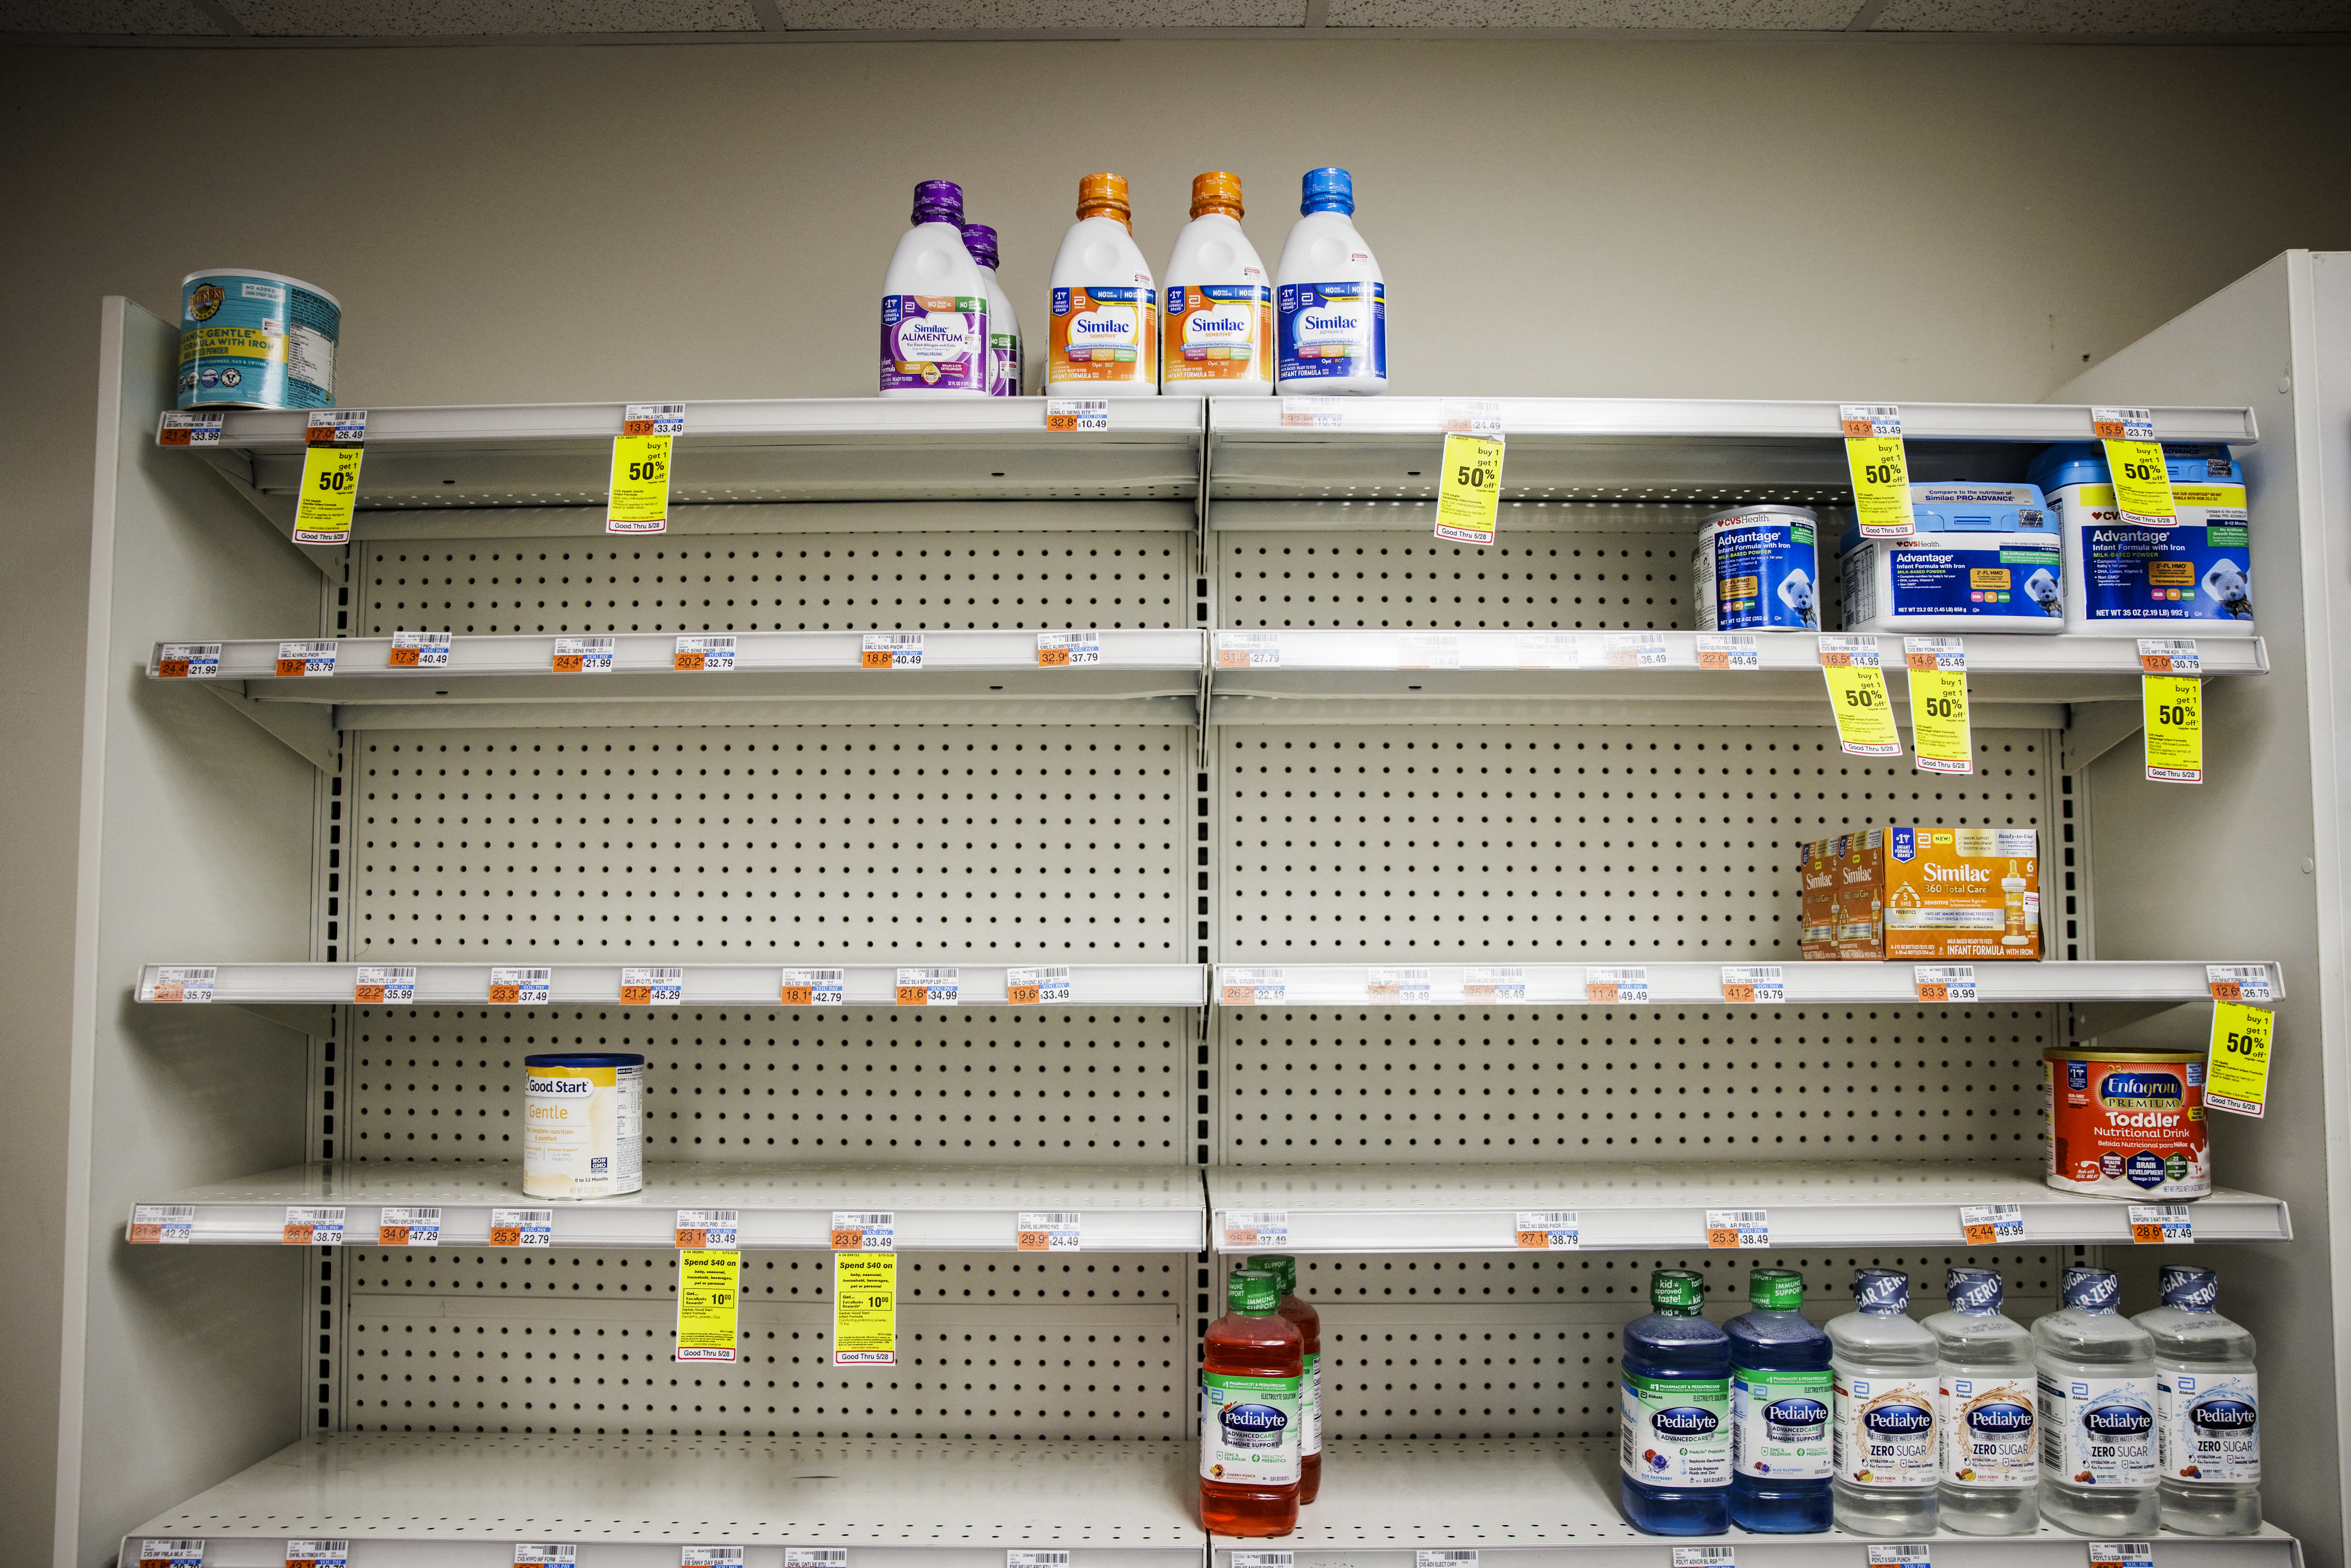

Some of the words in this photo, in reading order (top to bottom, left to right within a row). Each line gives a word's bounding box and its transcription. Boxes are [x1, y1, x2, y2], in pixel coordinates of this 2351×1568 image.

[208, 287, 224, 300] BEST
[1077, 319, 1129, 333] Similac
[1192, 318, 1244, 331] Similac
[249, 341, 274, 349] IRON
[655, 424, 682, 433] $33.49
[191, 433, 219, 441] $33.99
[335, 431, 363, 439] $26.49
[1719, 551, 1747, 560] MILK-BASED
[420, 655, 447, 664] $40.49
[583, 659, 611, 667] $21.99
[1069, 654, 1098, 662] $37.79
[1251, 654, 1279, 663] $27.79
[1730, 657, 1757, 665] $49.49
[189, 666, 216, 675] $21.99
[1924, 863, 1989, 882] Similac
[1925, 885, 1941, 893] 360
[1945, 885, 1965, 893] Total
[1967, 885, 1987, 893] Care
[1947, 945, 1974, 955] INFANT
[1975, 945, 2004, 955] FORMULA
[385, 990, 412, 998] $35.99
[651, 991, 680, 1000] $45.29
[813, 992, 841, 1002] $42.79
[1040, 990, 1069, 1000] $33.49
[1755, 990, 1783, 999] $19.79
[530, 1080, 553, 1092] Good
[2109, 1078, 2177, 1097] Enfagrow
[2109, 1099, 2176, 1108] PREMIUM
[529, 1105, 568, 1119] Gentle
[2105, 1112, 2180, 1128] Toddler
[2094, 1128, 2160, 1137] Nutritional
[2163, 1129, 2189, 1138] Drink
[410, 1232, 437, 1241] $47.29
[1996, 1226, 2023, 1237] $49.99
[2164, 1229, 2191, 1238] $27.49
[707, 1234, 735, 1244] $33.49
[1049, 1236, 1078, 1246] $24.49
[1660, 1280, 1672, 1288] kid
[1658, 1295, 1681, 1303] taste!
[1770, 1404, 1826, 1421] Pedialyte
[2197, 1408, 2254, 1424] Pedialyte
[1226, 1412, 1285, 1426] Pedialyte
[1657, 1414, 1716, 1430] Pedialyte
[1870, 1413, 1929, 1429] Pedialyte
[1972, 1412, 2031, 1427] Pedialyte
[2090, 1414, 2150, 1430] Pedialyte
[1870, 1445, 1894, 1456] ZERO
[1896, 1446, 1926, 1456] SUGAR
[2092, 1446, 2115, 1457] ZERO
[2117, 1446, 2148, 1457] SUGAR
